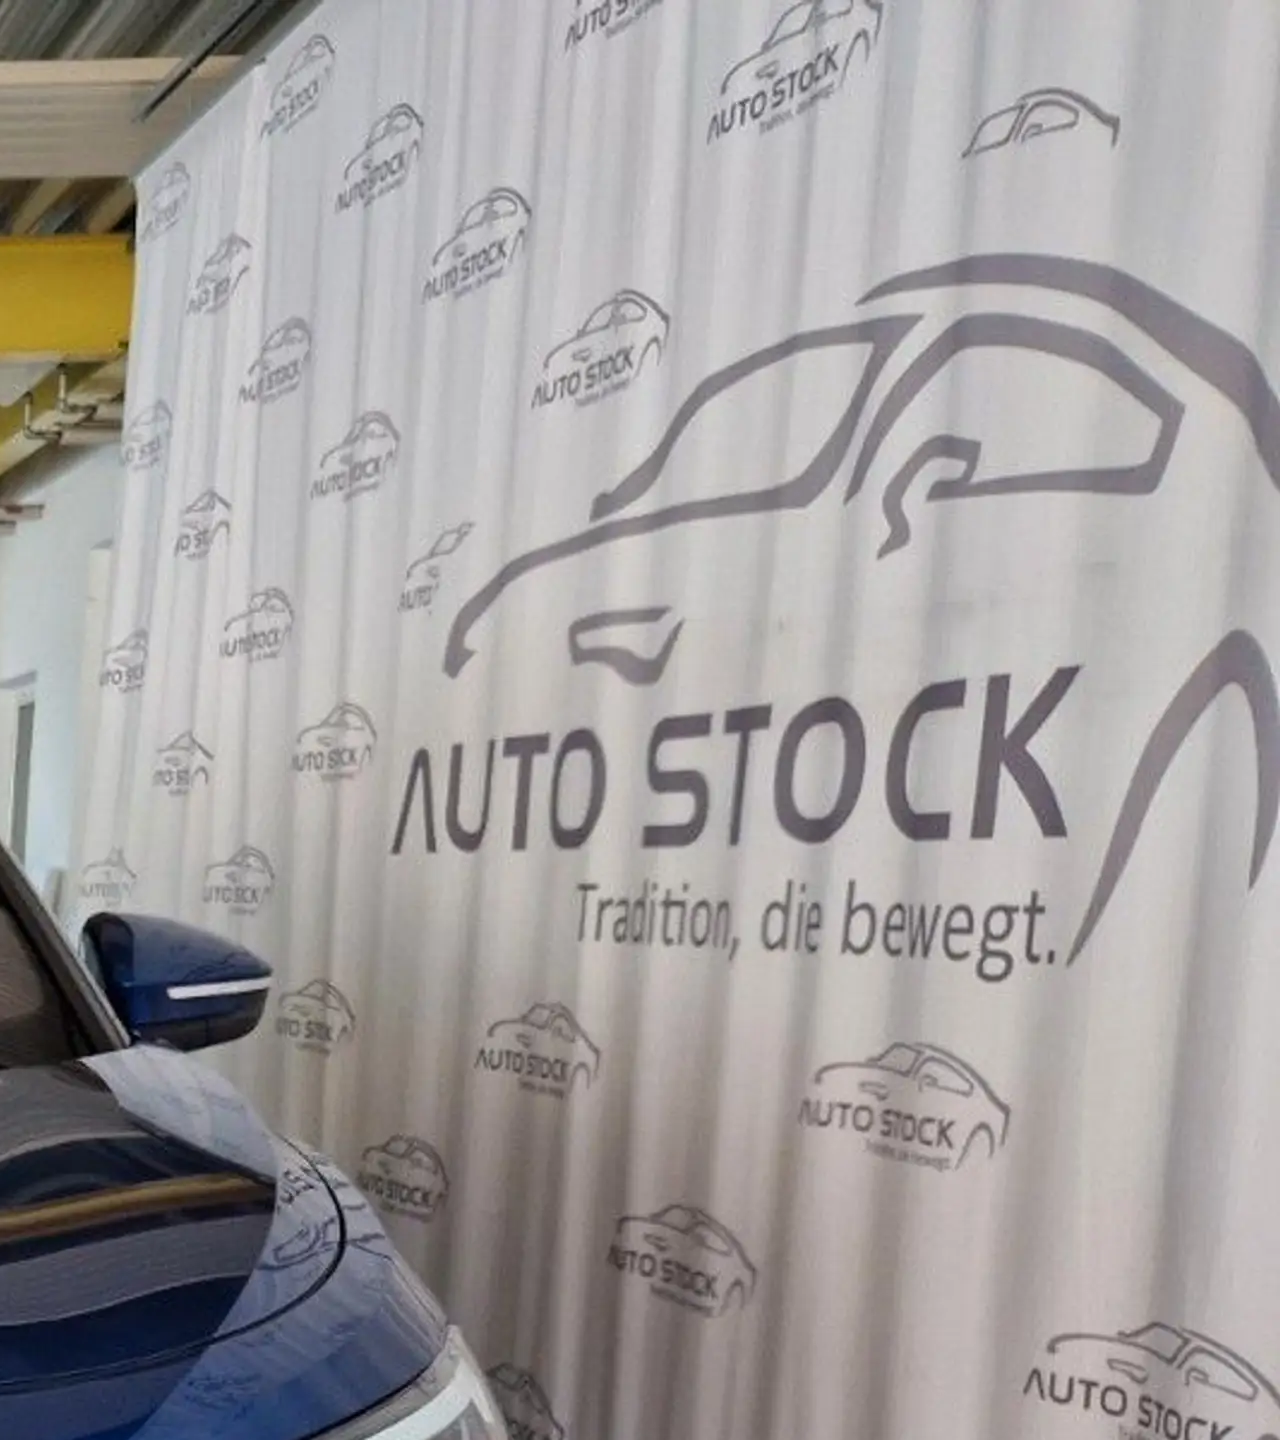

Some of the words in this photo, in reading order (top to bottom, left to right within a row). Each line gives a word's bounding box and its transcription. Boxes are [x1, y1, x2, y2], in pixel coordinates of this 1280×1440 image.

[706, 91, 767, 145] AUTO
[771, 44, 840, 109] STOCK
[460, 236, 508, 281] STOCK
[531, 370, 581, 409] AUTO
[584, 344, 635, 391] STOCK
[392, 728, 606, 853] AUTO
[642, 665, 1083, 849] STOCK
[576, 882, 739, 962] Tradition,
[760, 879, 822, 953] die
[840, 879, 1056, 984] bewegt.
[475, 1047, 523, 1075] AUTO
[798, 1098, 874, 1134] AUTO
[878, 1108, 955, 1149] STOCK
[1023, 1368, 1128, 1417] AUTO
